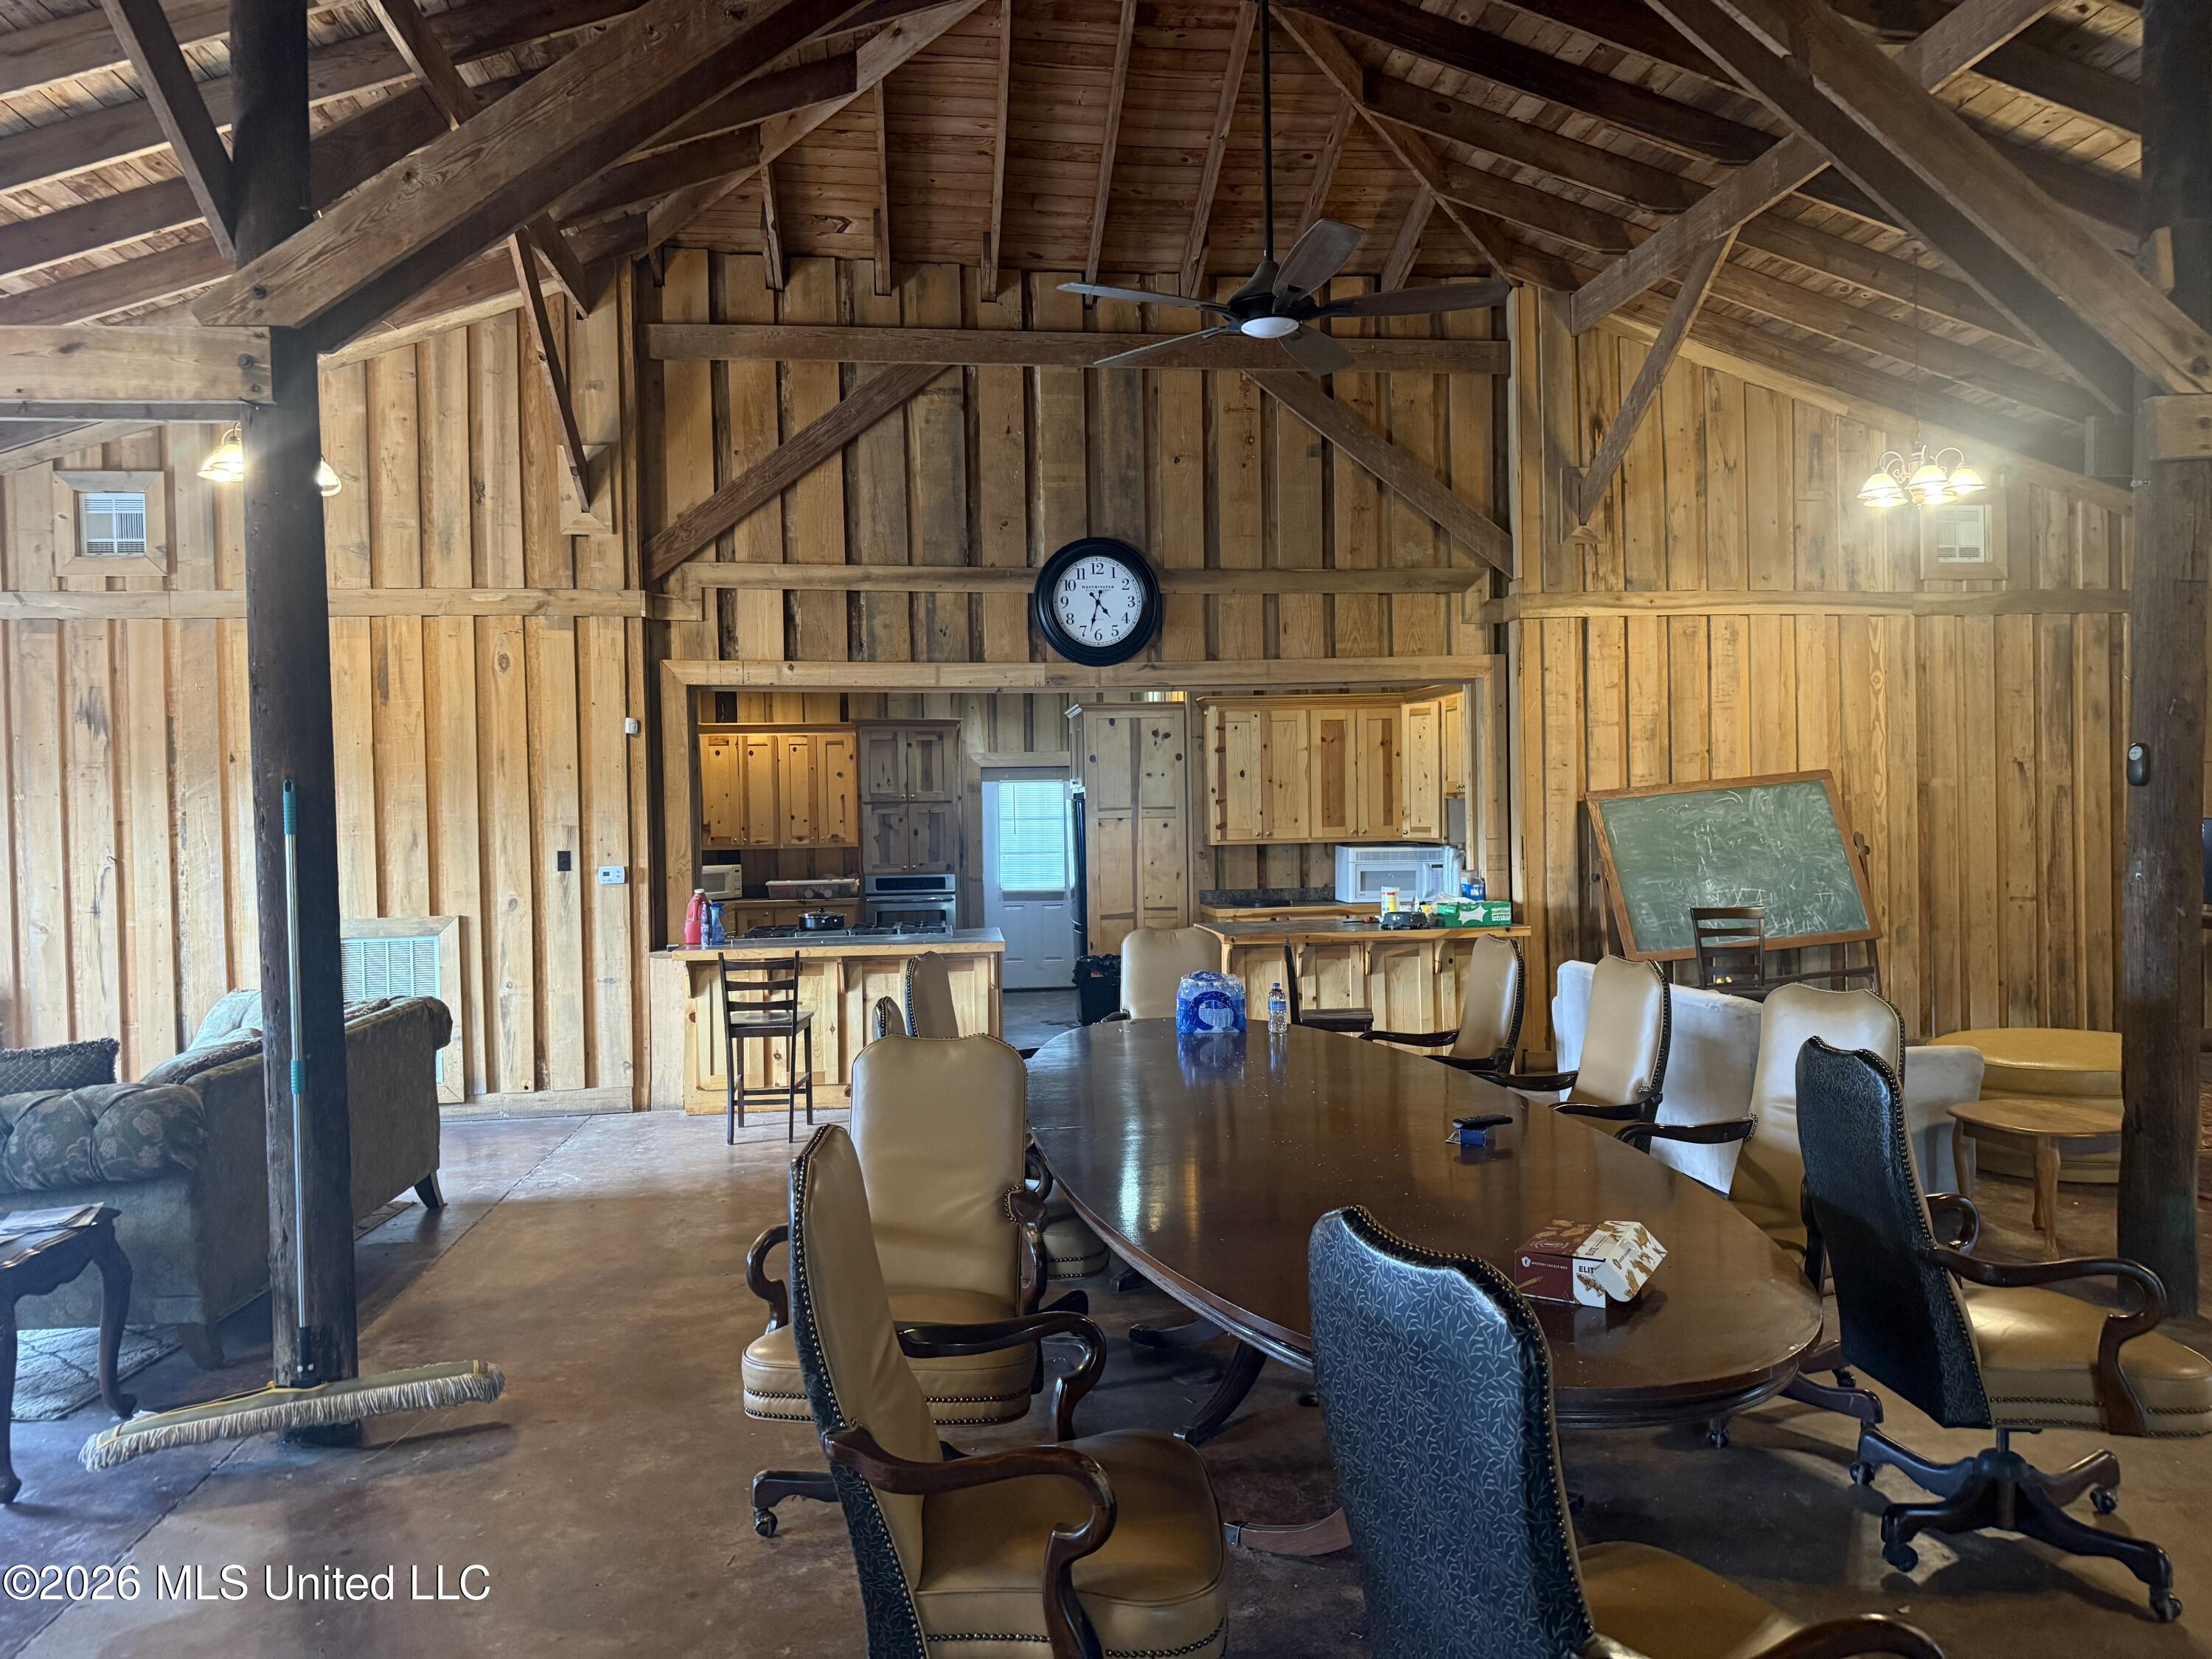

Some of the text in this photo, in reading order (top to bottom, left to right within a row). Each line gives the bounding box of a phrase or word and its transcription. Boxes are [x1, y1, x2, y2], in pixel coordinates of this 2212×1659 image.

[1075, 568, 1088, 580] 11
[1091, 563, 1105, 575] 12
[1110, 566, 1118, 579] 1
[1064, 579, 1077, 591] 10
[1121, 579, 1130, 591] 2
[1060, 596, 1069, 609] 9
[1127, 596, 1135, 608] 3
[1066, 613, 1075, 625] 8
[1121, 612, 1130, 625] 4
[1079, 625, 1088, 637] 7
[1094, 628, 1103, 641] 6
[1111, 625, 1119, 637] 5
[1579, 1265, 1596, 1274] ELIT
